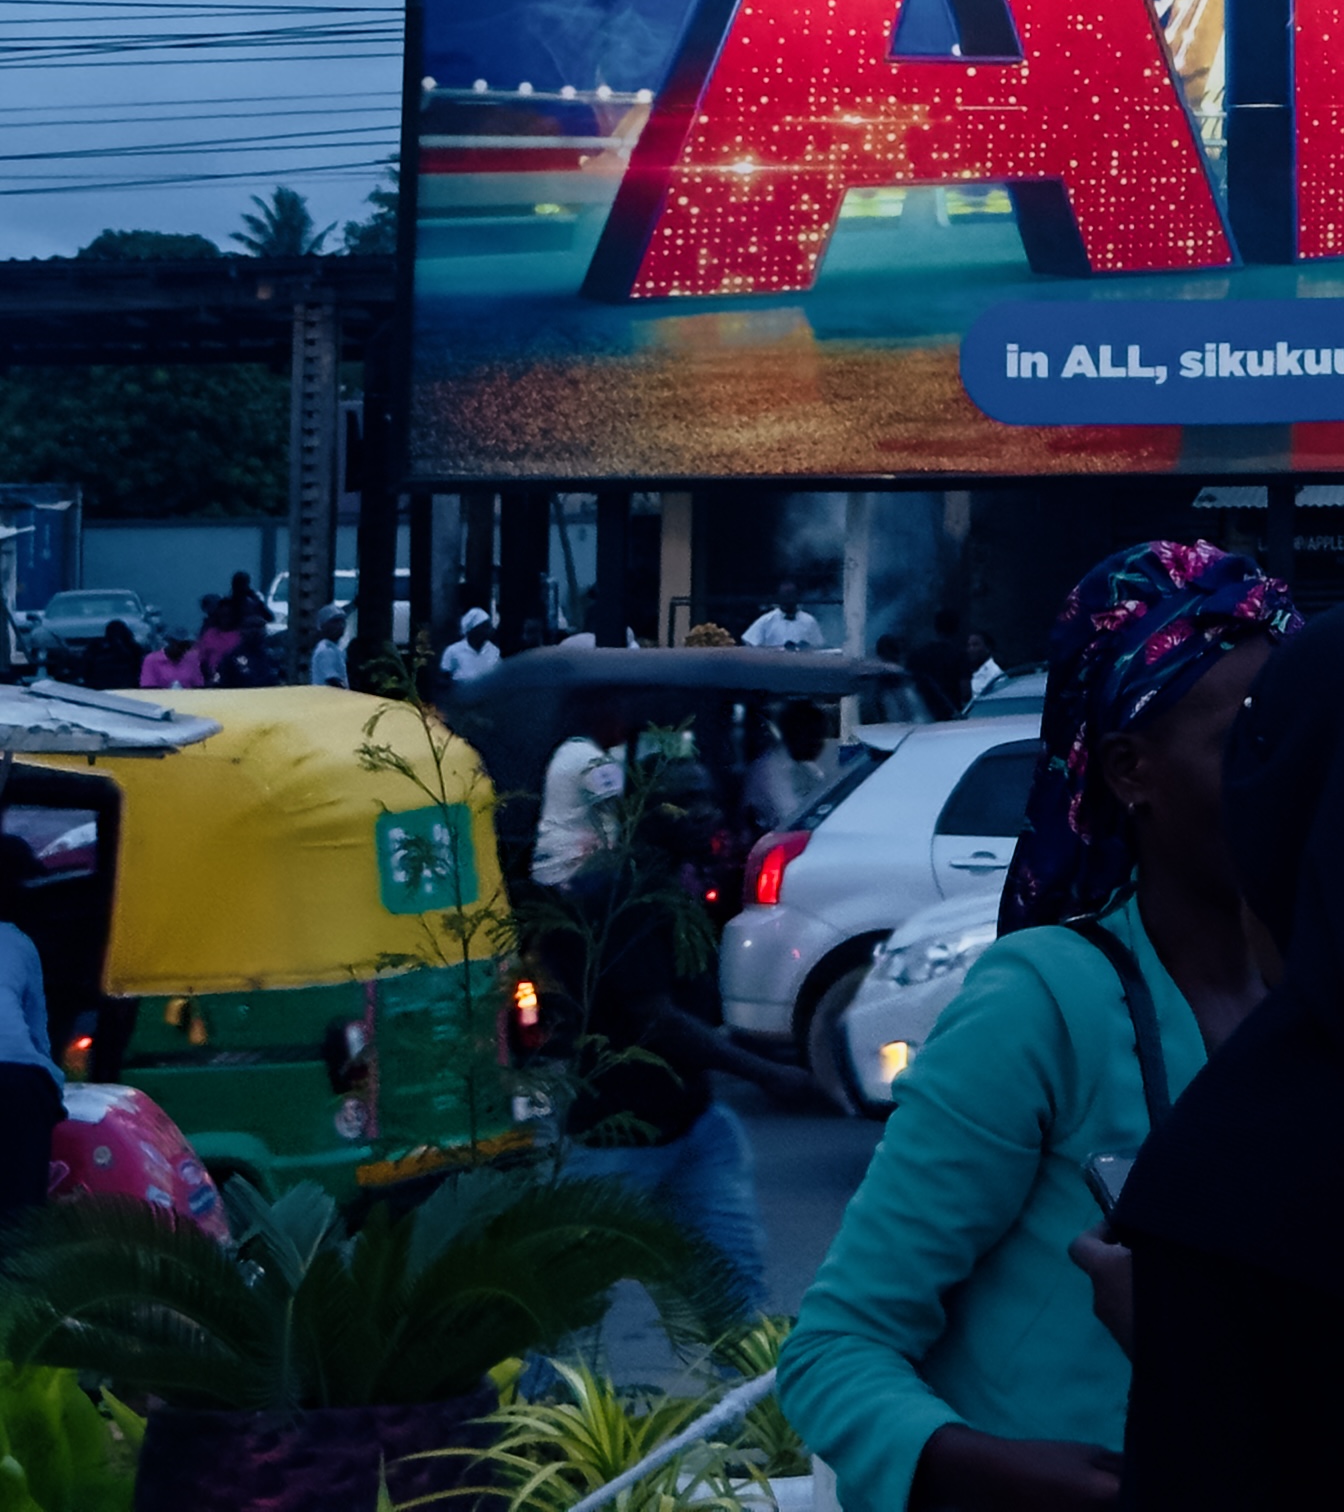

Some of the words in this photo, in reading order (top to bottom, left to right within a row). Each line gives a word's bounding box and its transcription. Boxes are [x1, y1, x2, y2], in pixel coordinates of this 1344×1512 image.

[1004, 343, 1049, 377] in
[1061, 342, 1167, 385] ALL,
[1307, 535, 1344, 550] APPLE
